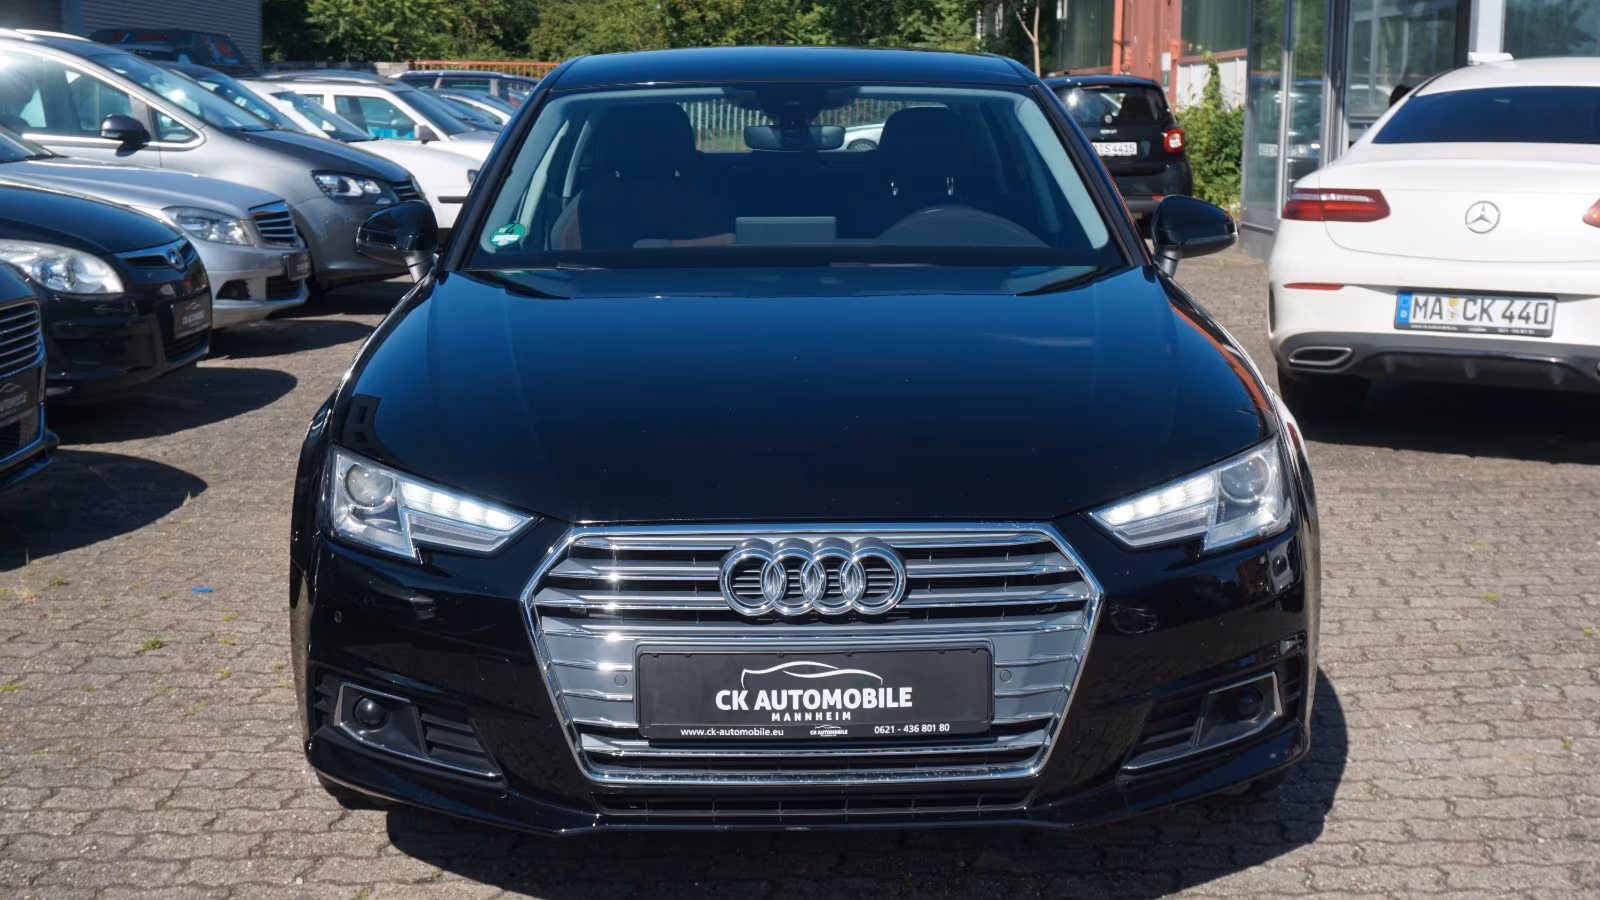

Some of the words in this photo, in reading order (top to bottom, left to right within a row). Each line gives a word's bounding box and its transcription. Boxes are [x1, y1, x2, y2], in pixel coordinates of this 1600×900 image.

[1112, 144, 1135, 153] 4415
[1401, 310, 1407, 318] D
[1412, 297, 1443, 321] MA
[1463, 299, 1495, 322] CK
[1501, 300, 1549, 325] 440
[715, 689, 749, 711] CK
[754, 687, 913, 711] AUTOMOBILE
[771, 711, 851, 722] MANNHEIM
[680, 727, 784, 736] www.ck-automobile.eu
[874, 725, 895, 734] 0621
[903, 724, 919, 733] 436
[921, 724, 936, 732] 801
[938, 723, 950, 732] 80
